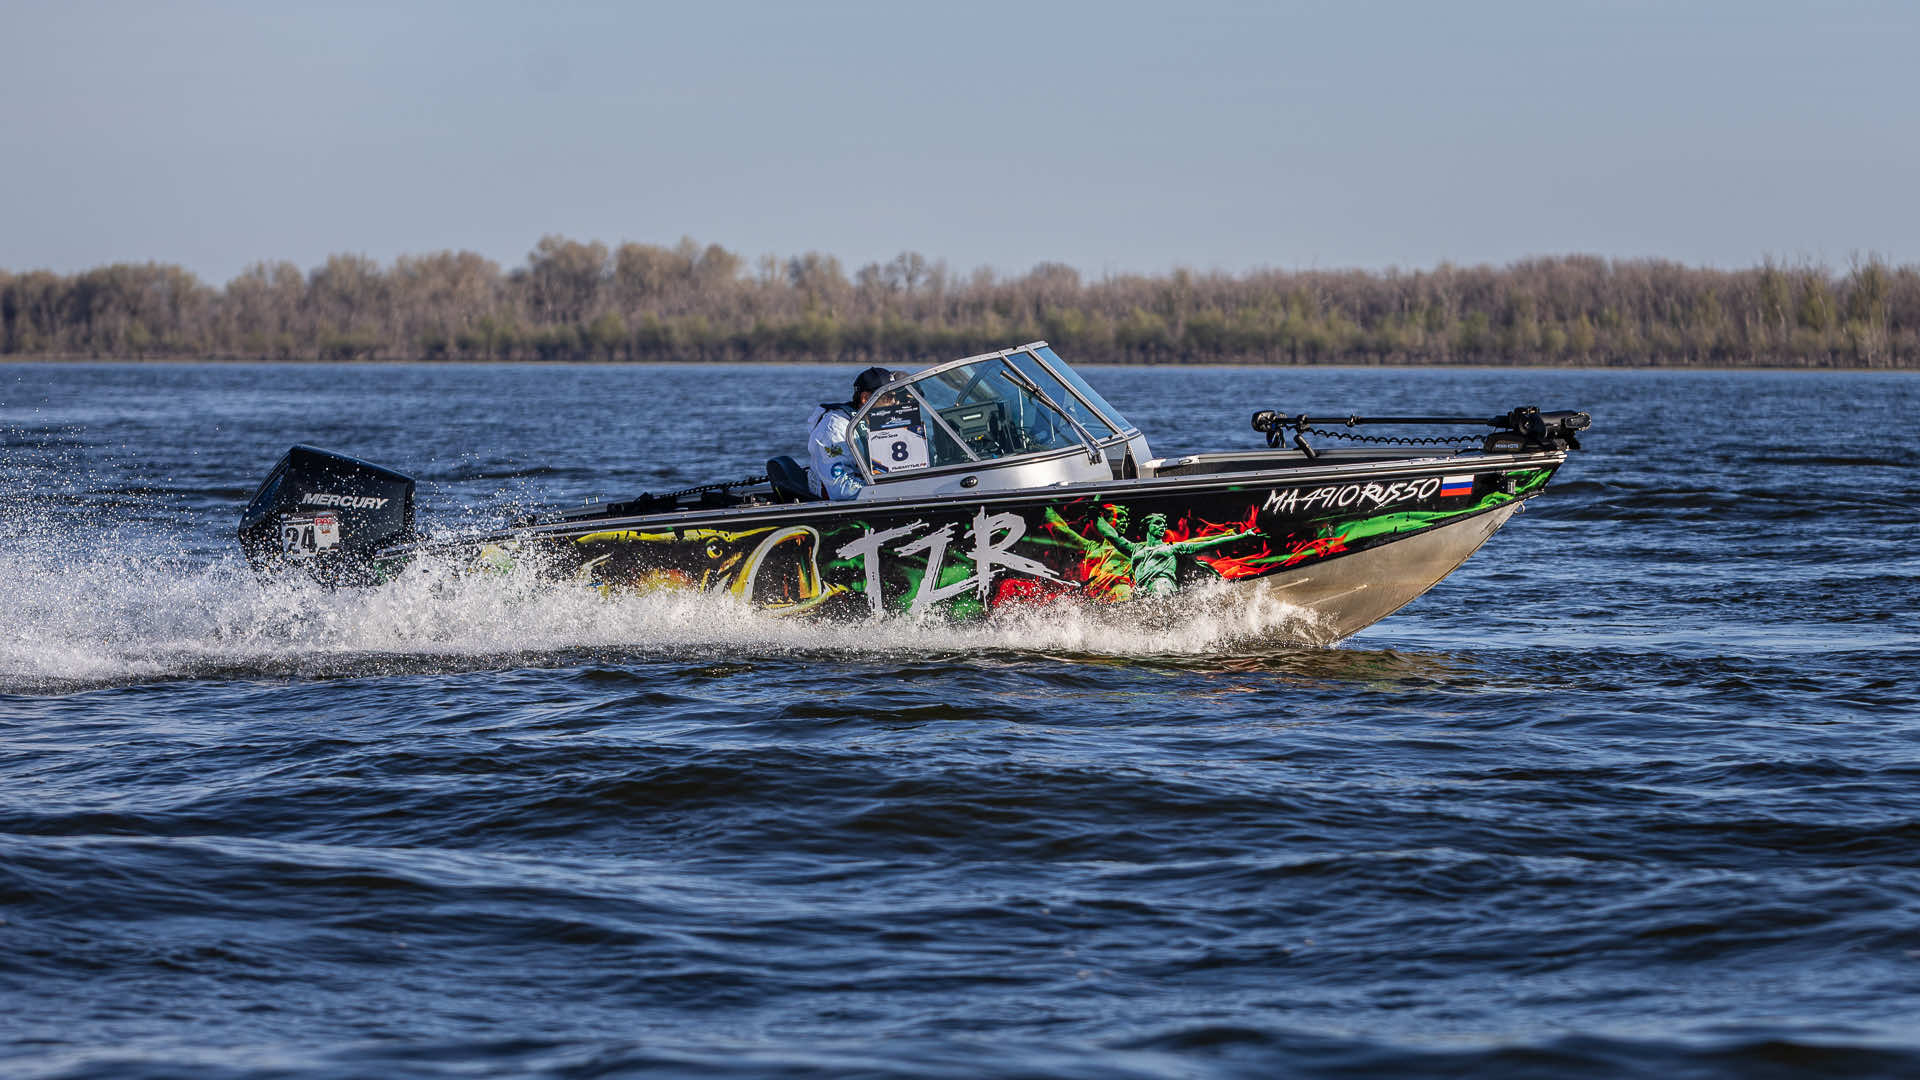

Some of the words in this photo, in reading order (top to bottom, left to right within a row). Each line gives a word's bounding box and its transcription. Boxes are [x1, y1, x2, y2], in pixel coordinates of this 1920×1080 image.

[891, 441, 909, 462] 8
[302, 493, 389, 509] MERCURY
[836, 506, 1081, 613] TZR
